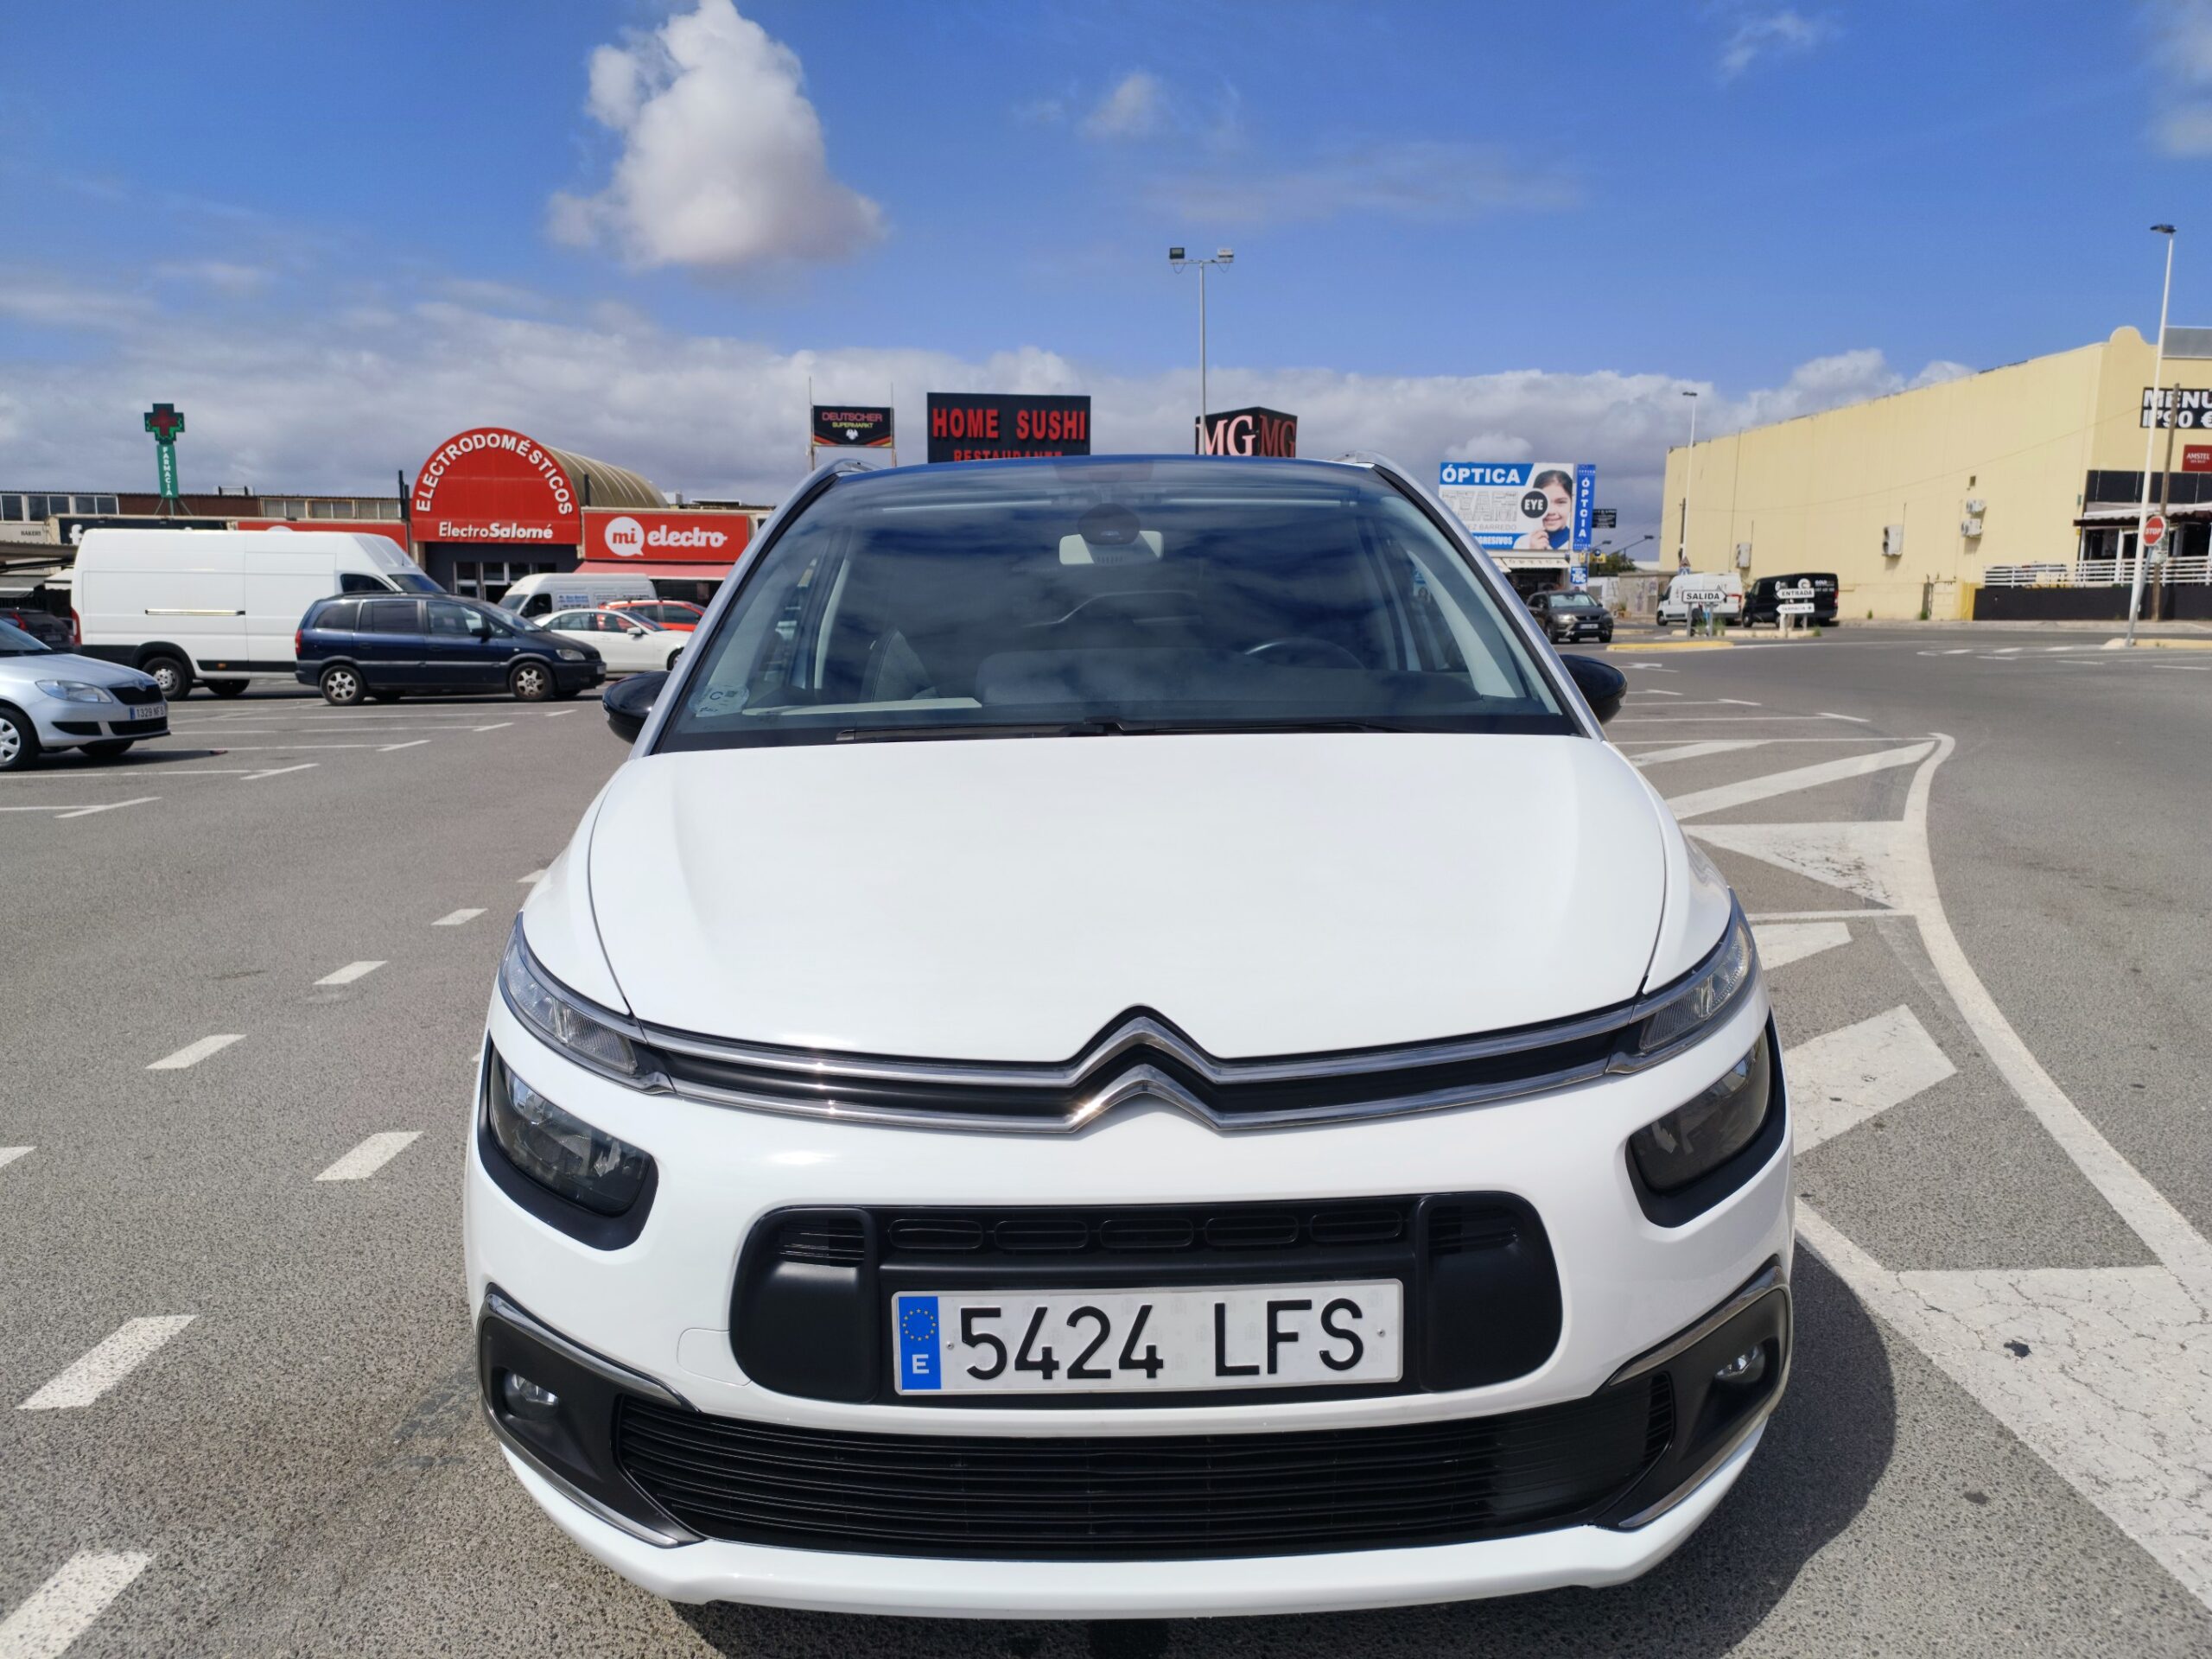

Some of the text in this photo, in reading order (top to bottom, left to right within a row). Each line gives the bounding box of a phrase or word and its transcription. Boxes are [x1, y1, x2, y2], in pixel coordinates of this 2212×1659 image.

[822, 411, 883, 423] DEUTSCHER
[932, 408, 1086, 441] HOME SUSHI
[1196, 415, 1256, 456] MG
[1259, 415, 1296, 458] MG
[2186, 452, 2210, 461] AMSTEL
[162, 446, 173, 496] FARMACIA
[416, 433, 573, 515] ELECTRODOMÉSTICOS
[1442, 464, 1521, 484] ÓPTICA
[1524, 499, 1544, 511] EYE
[439, 522, 554, 539] ElectroSalomé
[612, 524, 728, 548] mi electro
[709, 691, 724, 701] C
[960, 1298, 1364, 1380] 5424 LFS
[912, 1354, 930, 1375] E
